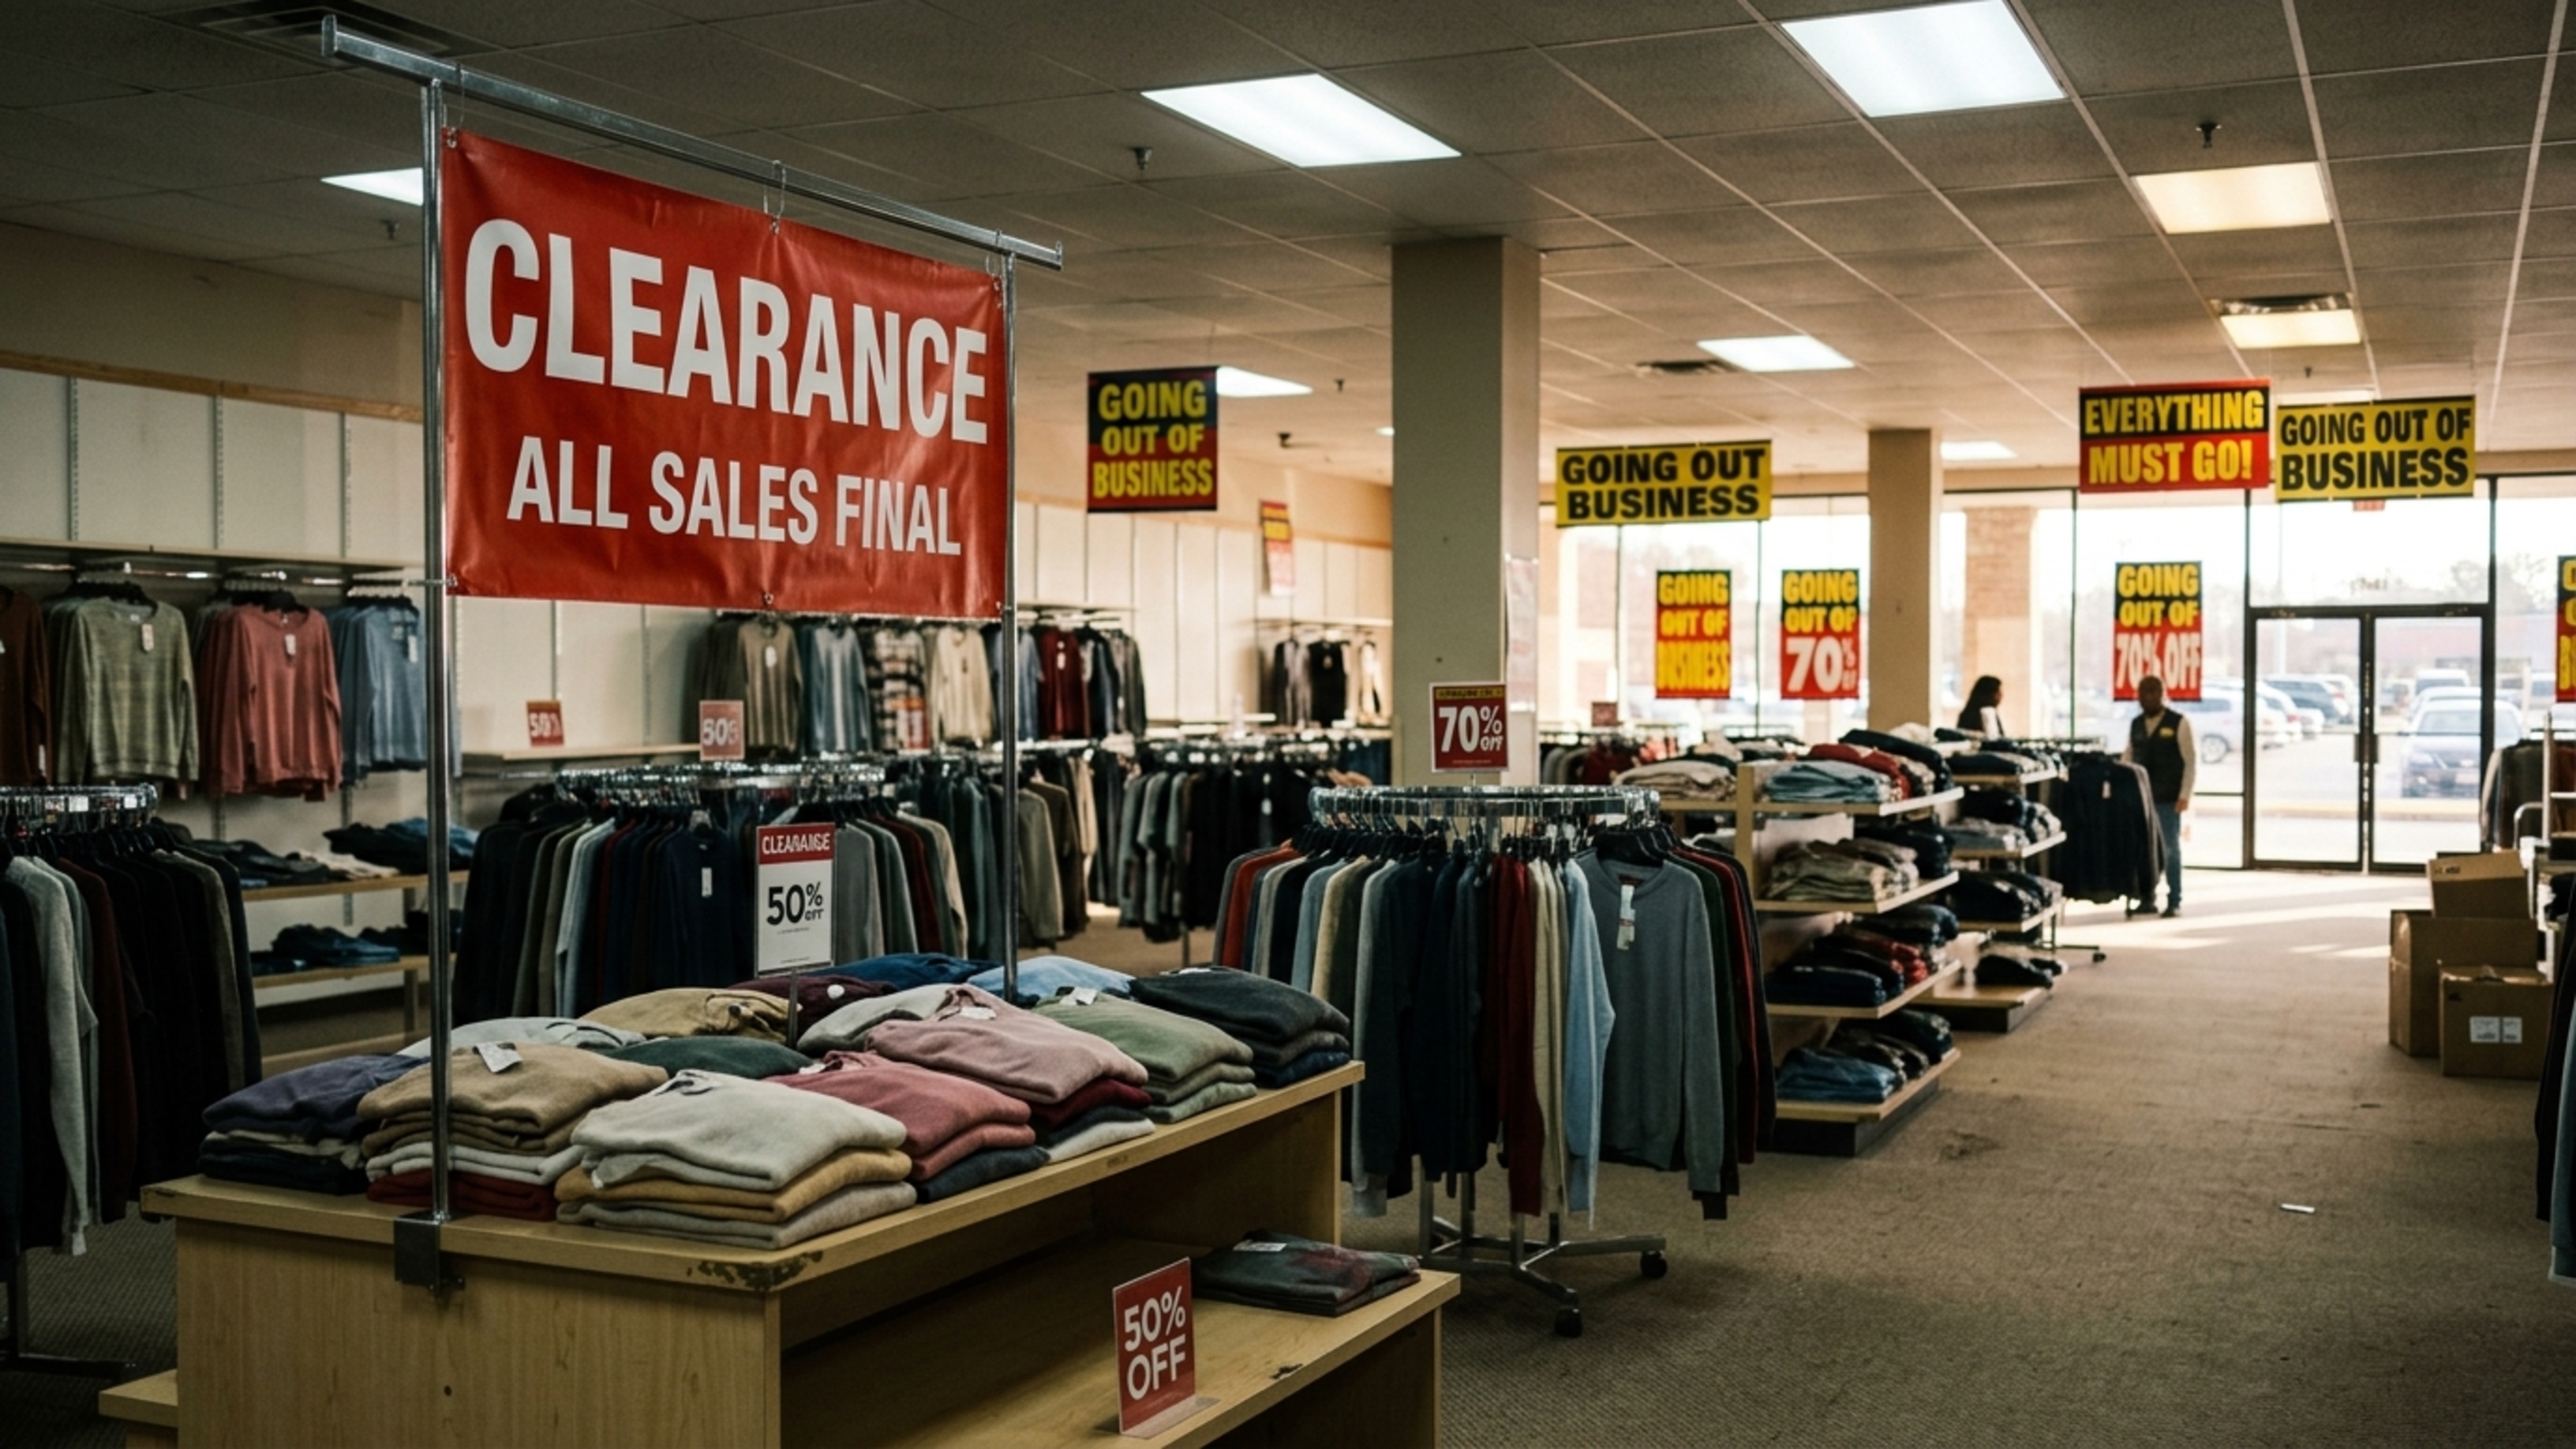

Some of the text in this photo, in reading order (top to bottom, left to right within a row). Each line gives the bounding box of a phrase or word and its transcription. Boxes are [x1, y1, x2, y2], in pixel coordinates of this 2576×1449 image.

[465, 219, 987, 445] CLEARANCE
[1098, 379, 1207, 420] GOING
[2085, 390, 2264, 434] EVERYTHING
[1101, 423, 1205, 456] OUT OF
[2281, 407, 2471, 445] GOING OUT OF
[1093, 458, 1213, 498] BUSINESS
[1562, 449, 1765, 485] GOING OUT
[2089, 439, 2252, 484] MUST GO!
[2282, 447, 2468, 491] BUSINESS
[506, 436, 961, 555] ALL SALES FINAL
[1568, 484, 1759, 520] BUSINESS
[1658, 572, 1728, 606] GOING
[1784, 571, 1857, 604] GOING
[2117, 564, 2199, 598] GOING
[1660, 609, 1699, 637] OUT
[1784, 606, 1827, 633] OUT
[2119, 600, 2199, 627] OUT OF
[2116, 632, 2200, 690] 70% OFF
[1438, 705, 1503, 753] 70%
[767, 881, 824, 926] 50%
[1124, 1285, 1186, 1352] 50%
[1127, 1334, 1186, 1401] OFF
